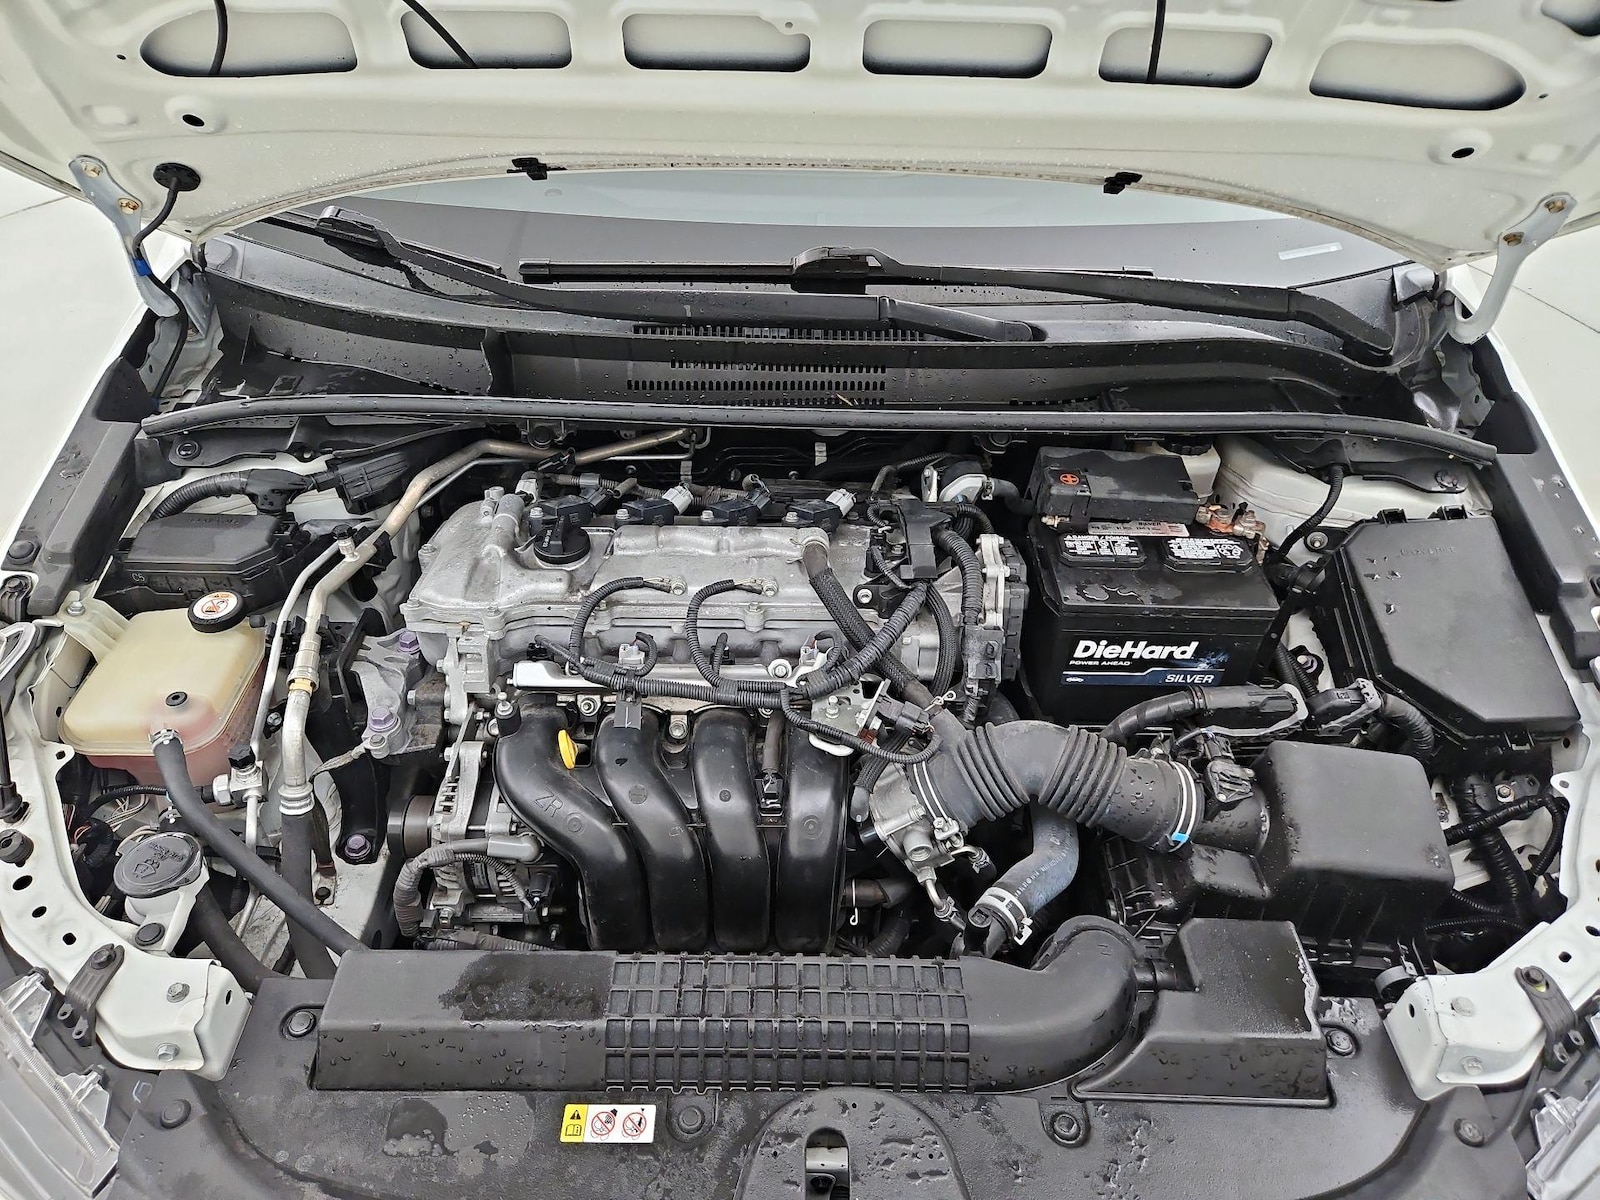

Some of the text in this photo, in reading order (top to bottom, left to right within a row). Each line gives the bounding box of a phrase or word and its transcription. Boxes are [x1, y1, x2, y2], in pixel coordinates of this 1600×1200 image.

[1073, 640, 1199, 660] DieHard
[1165, 674, 1215, 683] SILVER
[533, 786, 564, 818] ZR
